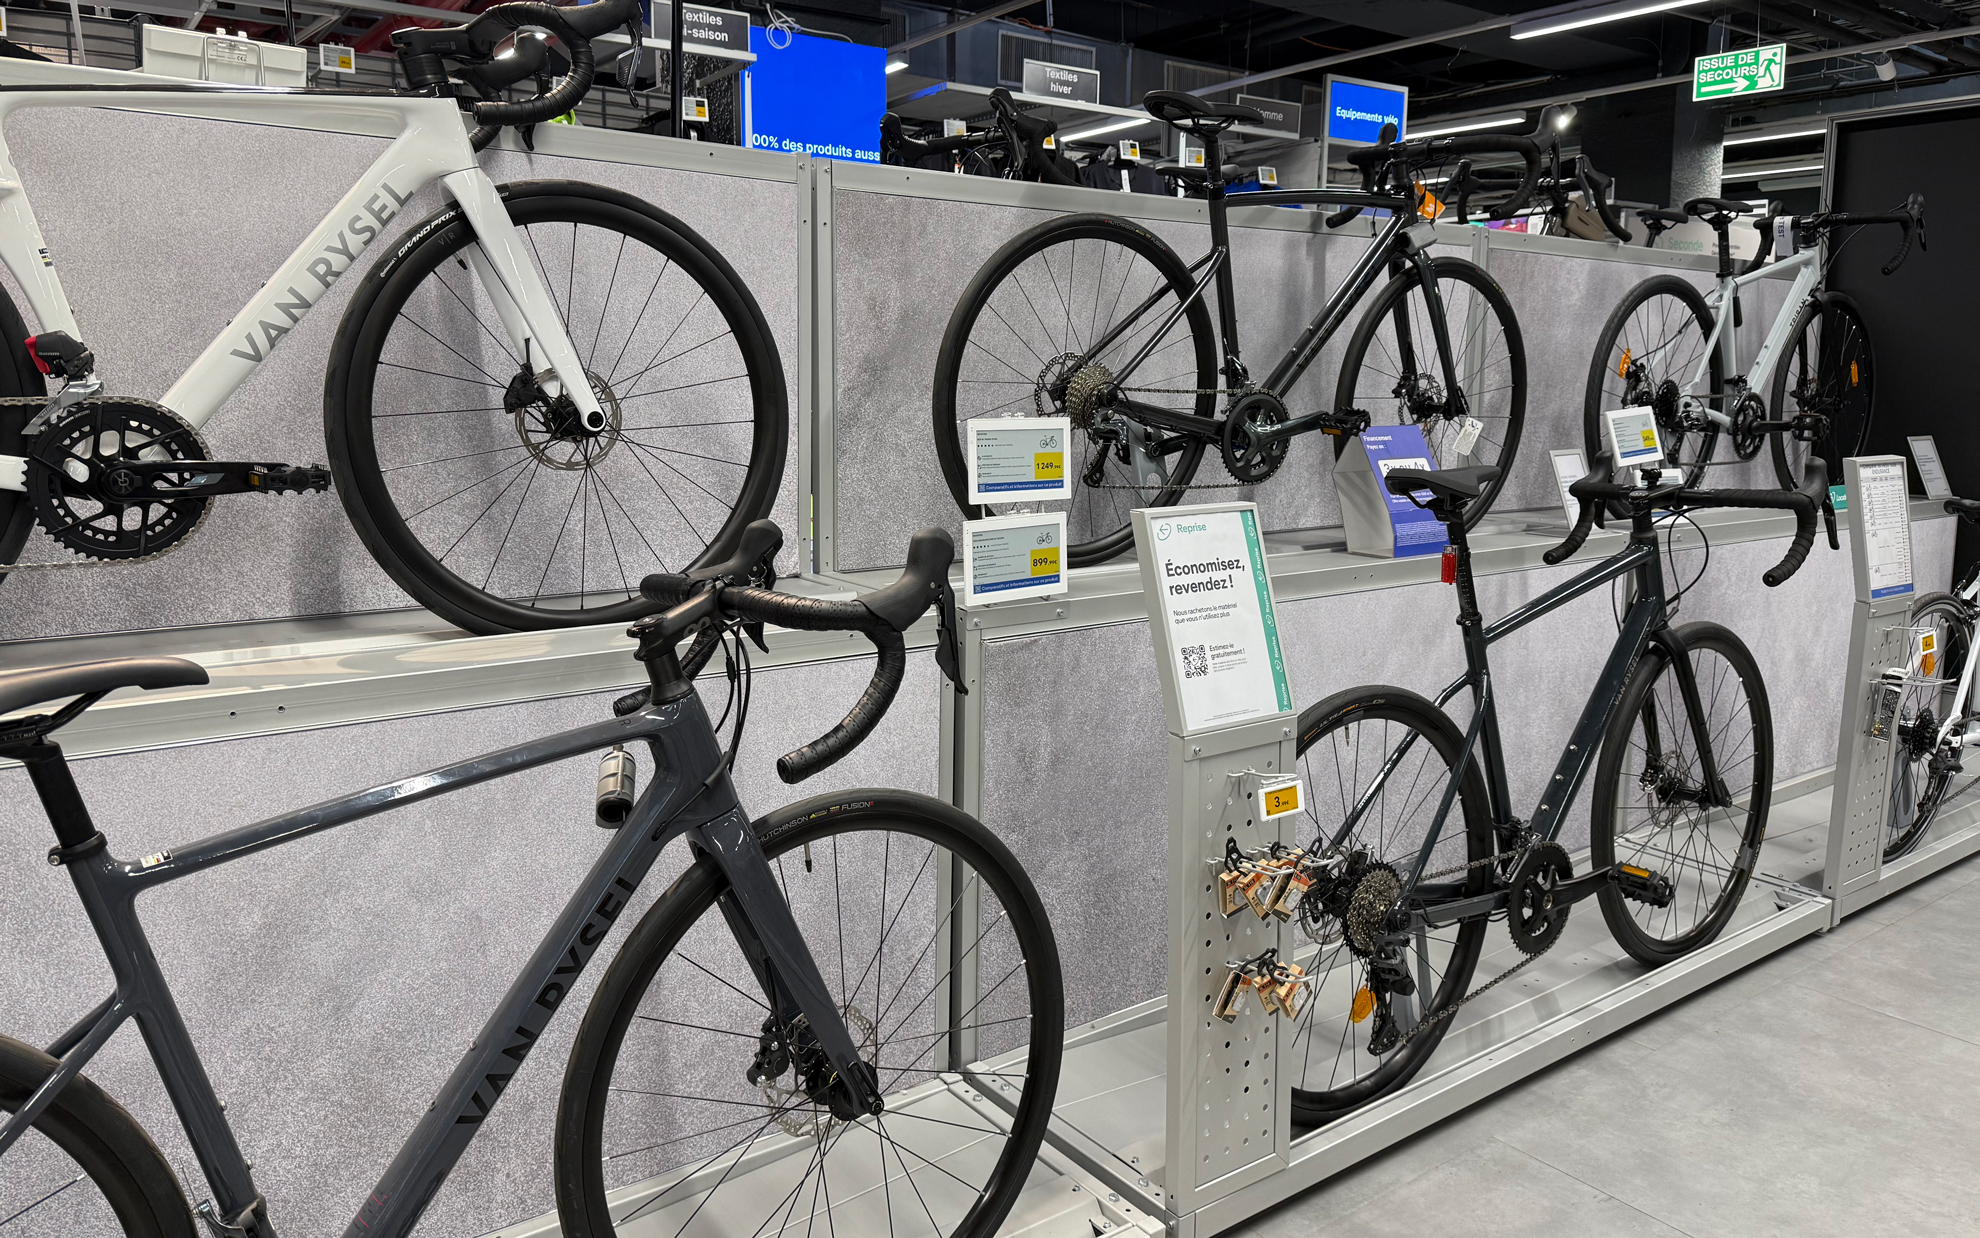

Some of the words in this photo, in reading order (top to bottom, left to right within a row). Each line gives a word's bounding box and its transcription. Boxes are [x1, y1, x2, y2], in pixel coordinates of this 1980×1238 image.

[683, 24, 729, 42] i-saison
[1699, 56, 1735, 71] ISSUE
[1738, 52, 1756, 65] DE
[1044, 67, 1078, 83] Textiles
[1698, 65, 1758, 83] SECOURS
[1050, 81, 1072, 95] hiver
[1253, 107, 1284, 122] omme
[1336, 106, 1383, 123] Equipements
[752, 133, 779, 149] 00%
[782, 138, 804, 152] des
[806, 144, 852, 158] produits
[854, 150, 881, 161] auss
[398, 226, 431, 258] GRAND
[431, 209, 457, 230] PRIX
[1777, 220, 1785, 239] TEST
[1668, 236, 1704, 252] Seconde
[230, 285, 313, 363] VAN
[305, 181, 415, 290] RYSEL
[1176, 522, 1207, 534] Reprise
[1254, 547, 1262, 569] Reprise
[1165, 557, 1245, 578] Économisez,
[1168, 576, 1228, 596] revendez
[1173, 609, 1188, 617] Nous
[1187, 607, 1213, 615] rachetons
[1217, 601, 1238, 610] matériel
[1219, 610, 1231, 618] plus
[1210, 648, 1243, 660] gratuitement
[758, 815, 809, 843] HUTCHINSON
[841, 801, 871, 812] FUSION
[455, 1025, 538, 1125] VAN
